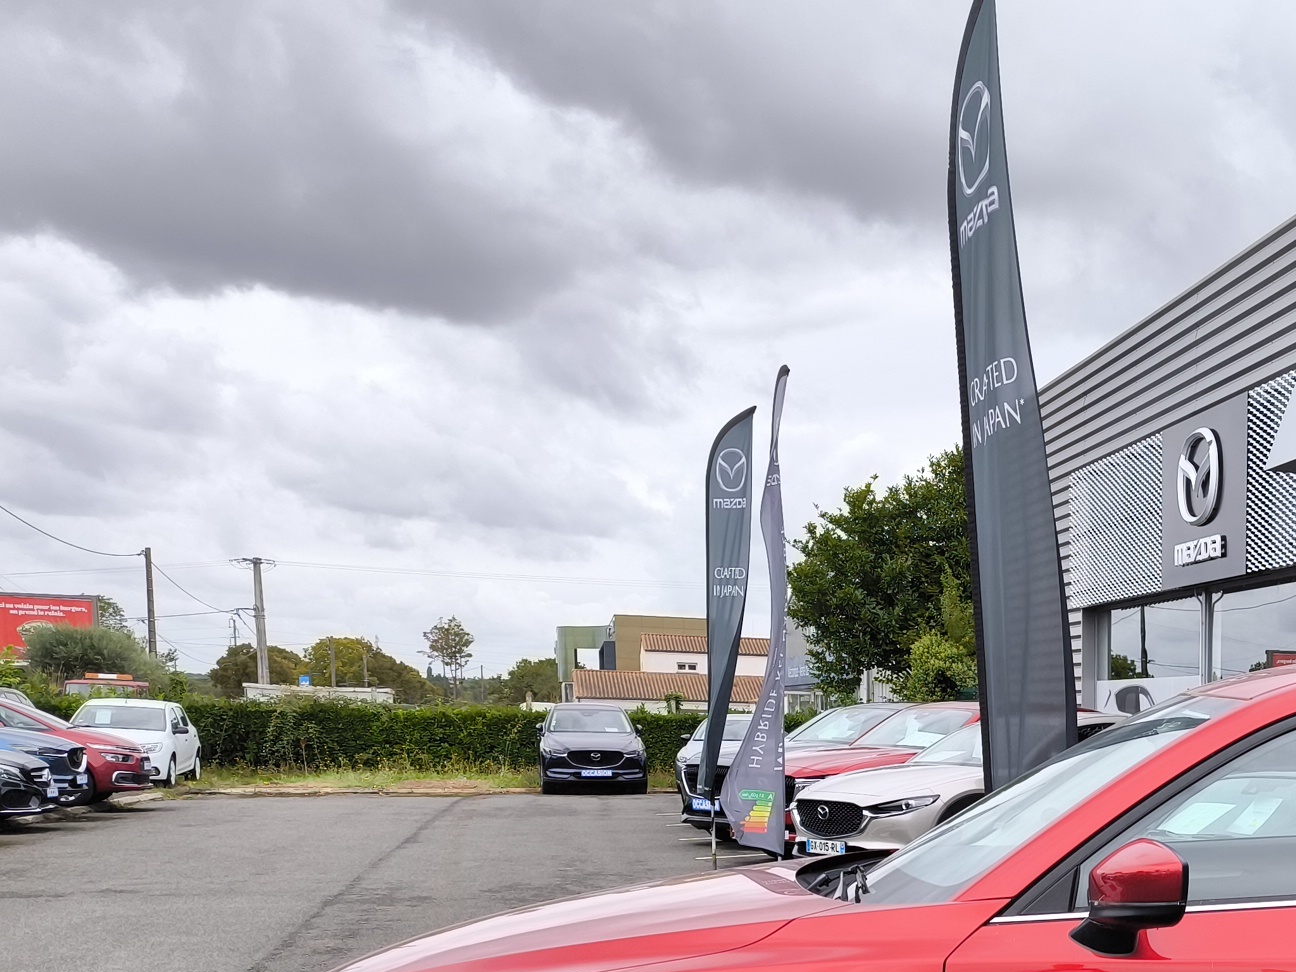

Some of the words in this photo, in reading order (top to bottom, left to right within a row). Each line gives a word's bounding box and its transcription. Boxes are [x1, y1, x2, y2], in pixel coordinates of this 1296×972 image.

[970, 357, 1018, 407] CRATED
[1174, 534, 1222, 567] mazda
[692, 799, 720, 811] OCCASIN
